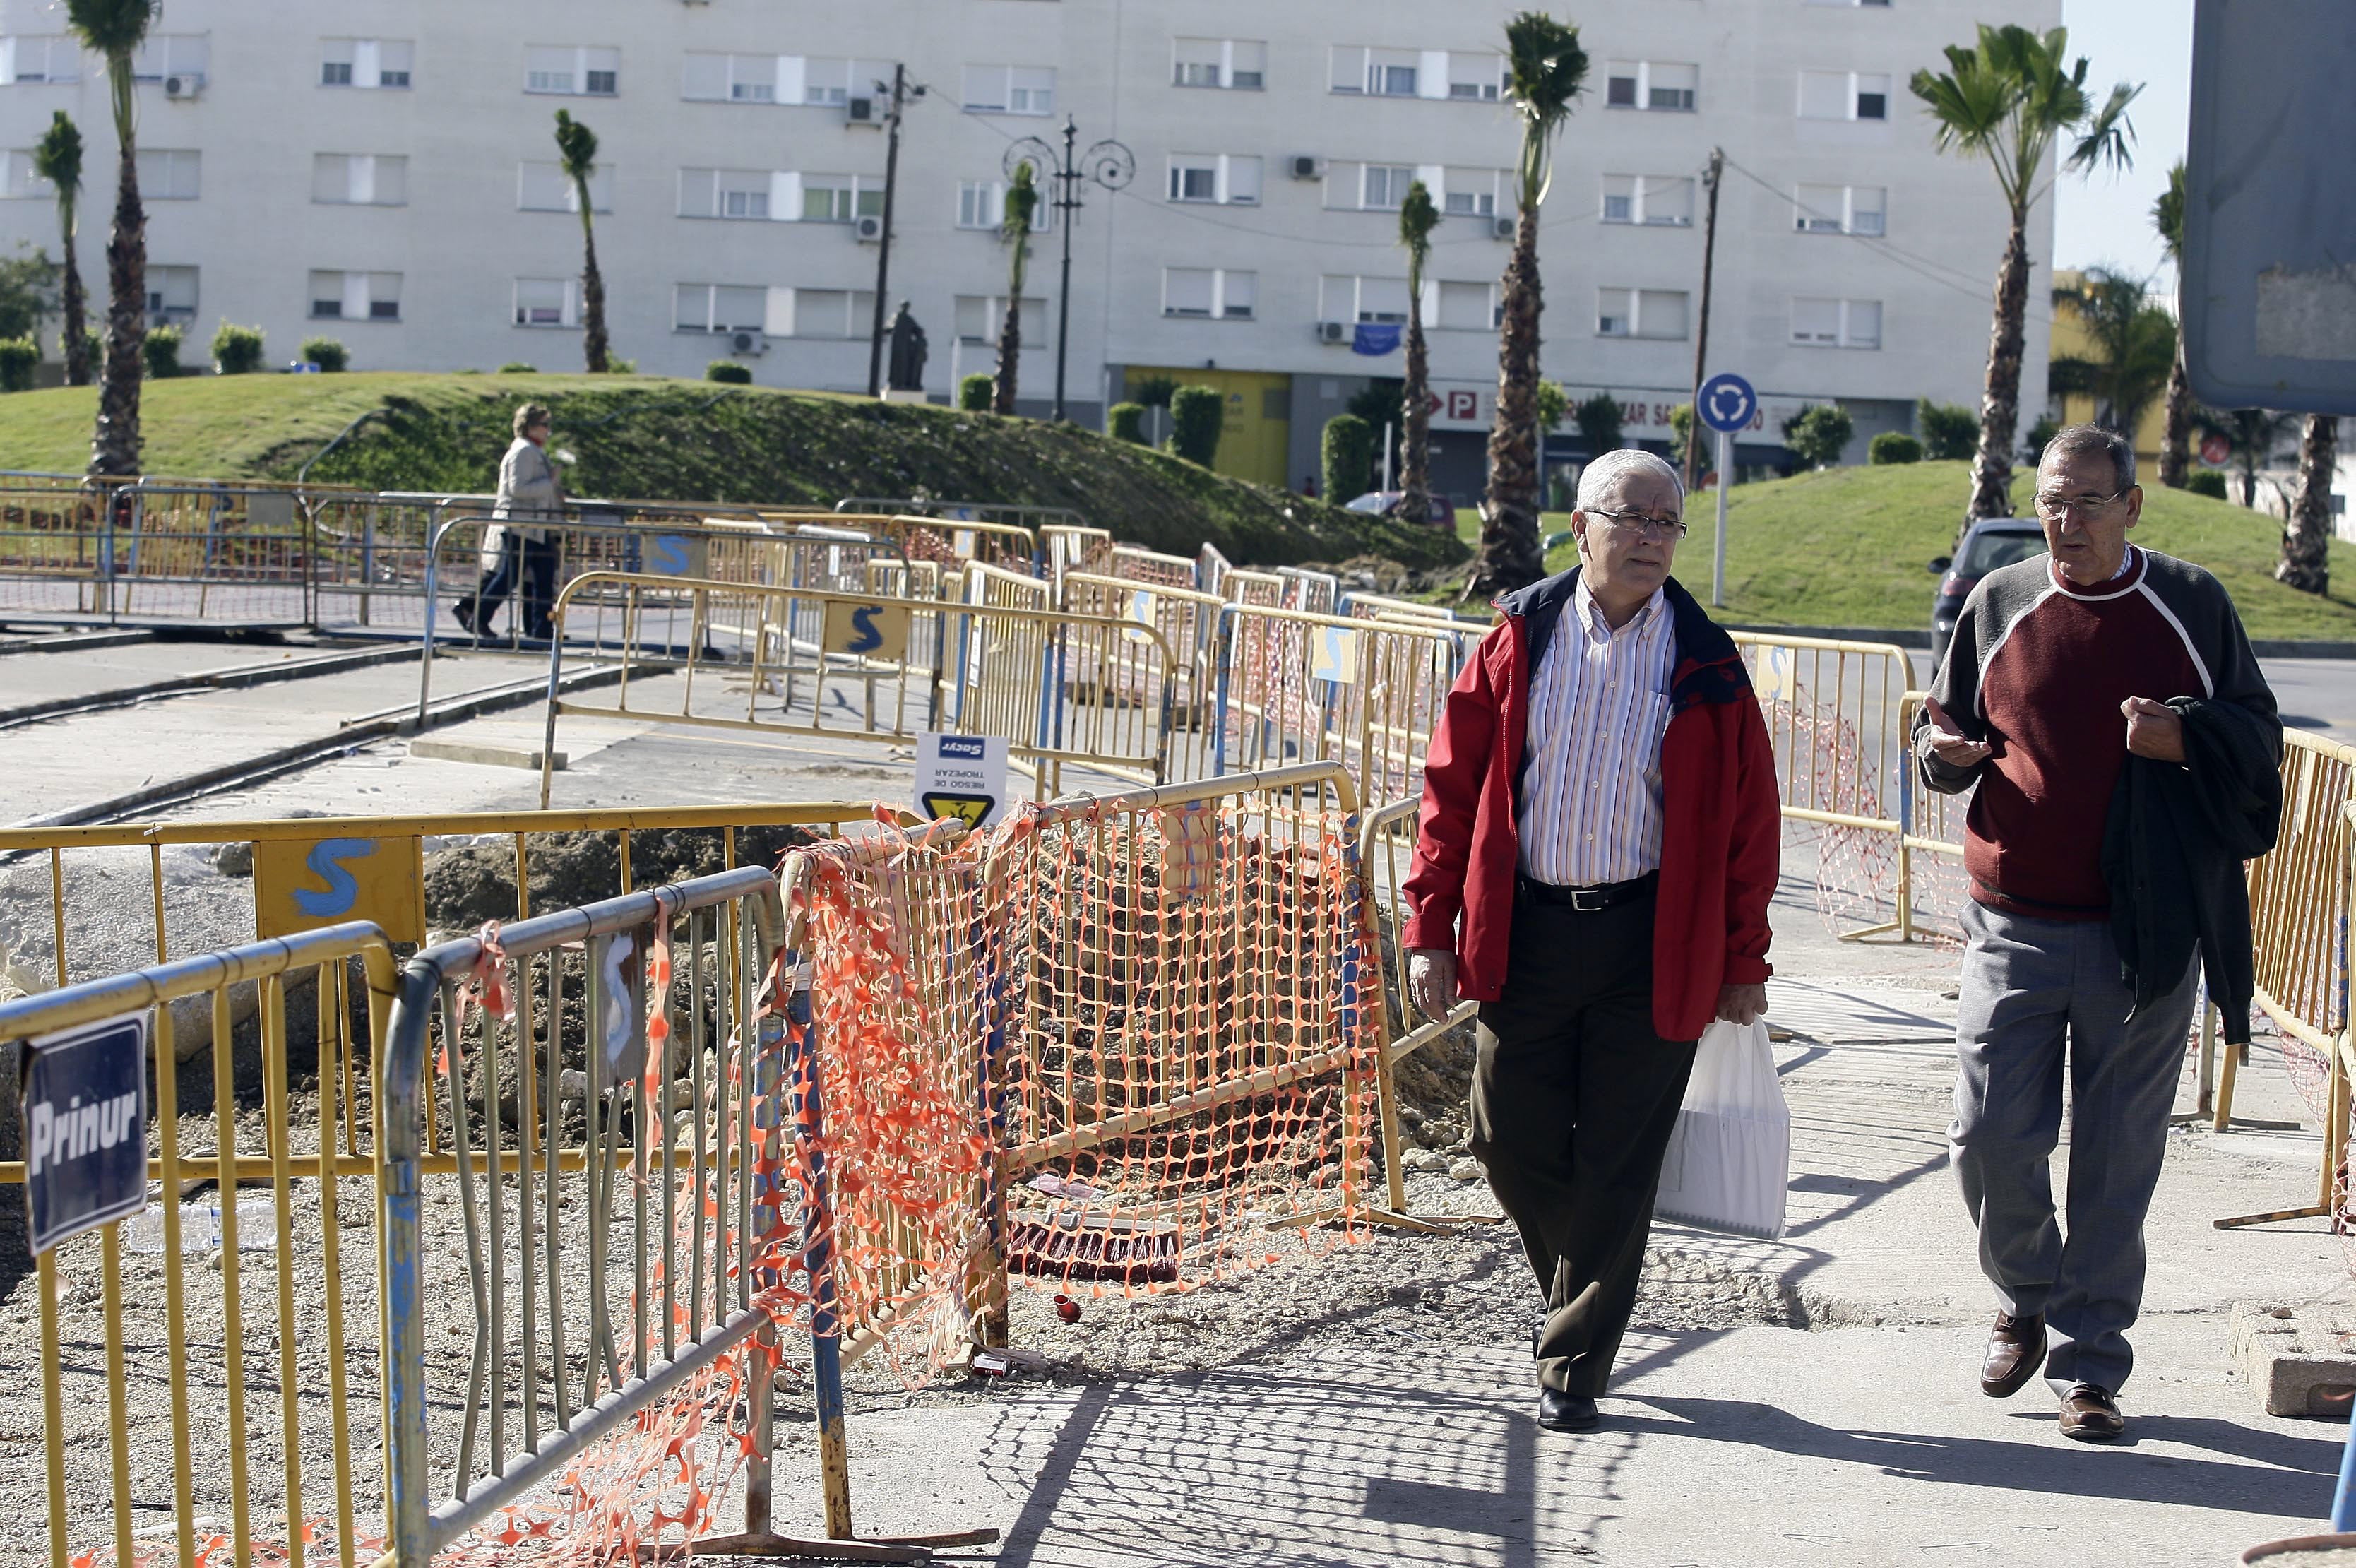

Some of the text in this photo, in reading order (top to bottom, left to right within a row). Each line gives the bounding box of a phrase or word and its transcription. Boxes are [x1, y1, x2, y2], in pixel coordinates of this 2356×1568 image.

[1453, 394, 1473, 420] P
[941, 742, 982, 755] Sacyr
[935, 768, 984, 778] TROPEZAR
[951, 780, 984, 789] RIESGO
[290, 838, 380, 917] S
[31, 1090, 137, 1177] Prinur
